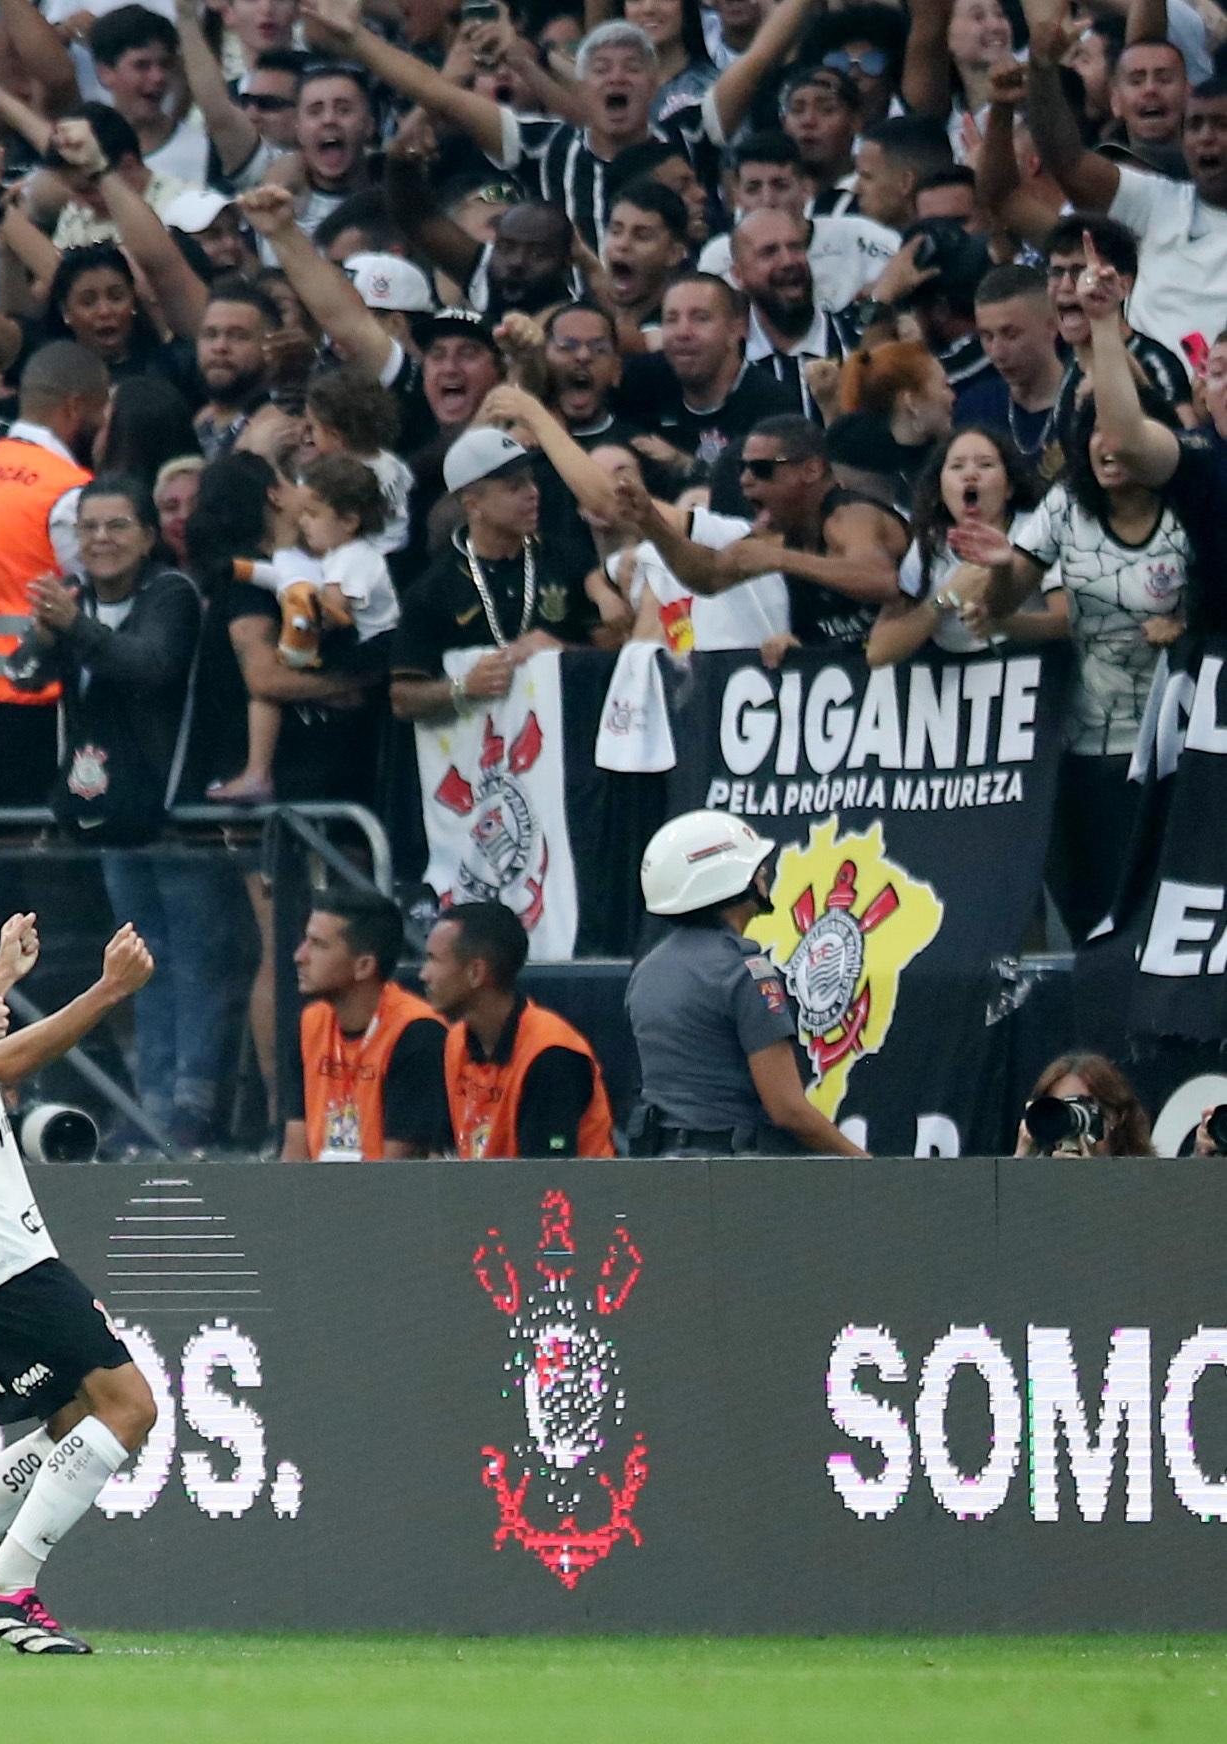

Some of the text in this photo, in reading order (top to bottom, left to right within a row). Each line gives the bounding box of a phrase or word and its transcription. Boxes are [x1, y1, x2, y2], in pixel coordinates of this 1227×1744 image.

[720, 657, 1041, 776] GIGANTE
[706, 771, 1023, 815] PELA PRÓPRIA NATUREZA
